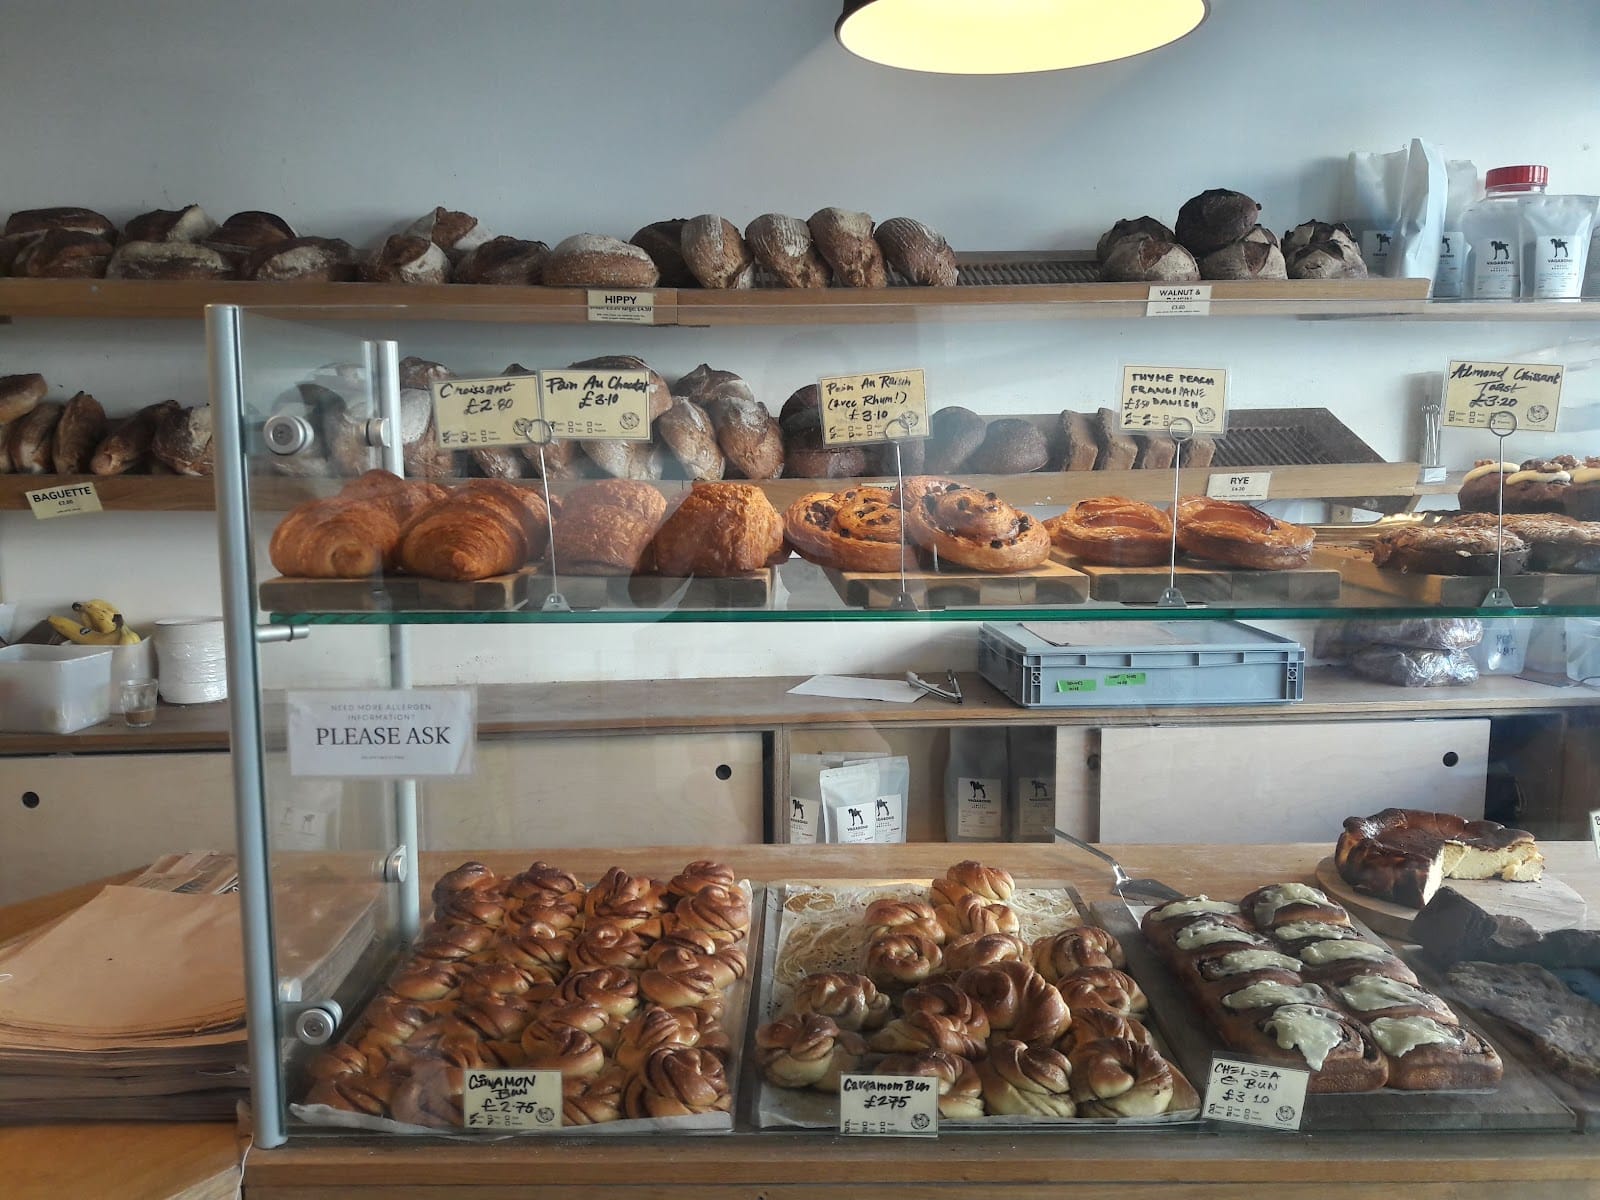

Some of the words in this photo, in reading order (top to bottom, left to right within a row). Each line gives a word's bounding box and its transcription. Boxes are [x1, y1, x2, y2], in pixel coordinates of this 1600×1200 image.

[604, 295, 637, 304] HIPPY
[1160, 289, 1194, 297] WALNUT
[1450, 363, 1509, 379] Almond
[545, 377, 579, 395] Pain
[582, 374, 604, 391] Au
[861, 377, 876, 390] Au
[1132, 373, 1174, 382] THYME
[1179, 374, 1215, 386] PEACH
[440, 382, 516, 399] Croissant
[1473, 379, 1528, 394] Toast
[1152, 397, 1199, 409] DANISH
[1230, 476, 1249, 484] RYE
[32, 486, 92, 503] BAGUETTE
[386, 703, 432, 711] ALLERGEN
[347, 713, 416, 721] INFORMATION?
[316, 727, 401, 746] PLEASE
[405, 726, 451, 745] ASK
[1214, 1063, 1281, 1080] CHELSEA
[904, 1080, 930, 1091] Bun
[1243, 1078, 1278, 1091] BUN
